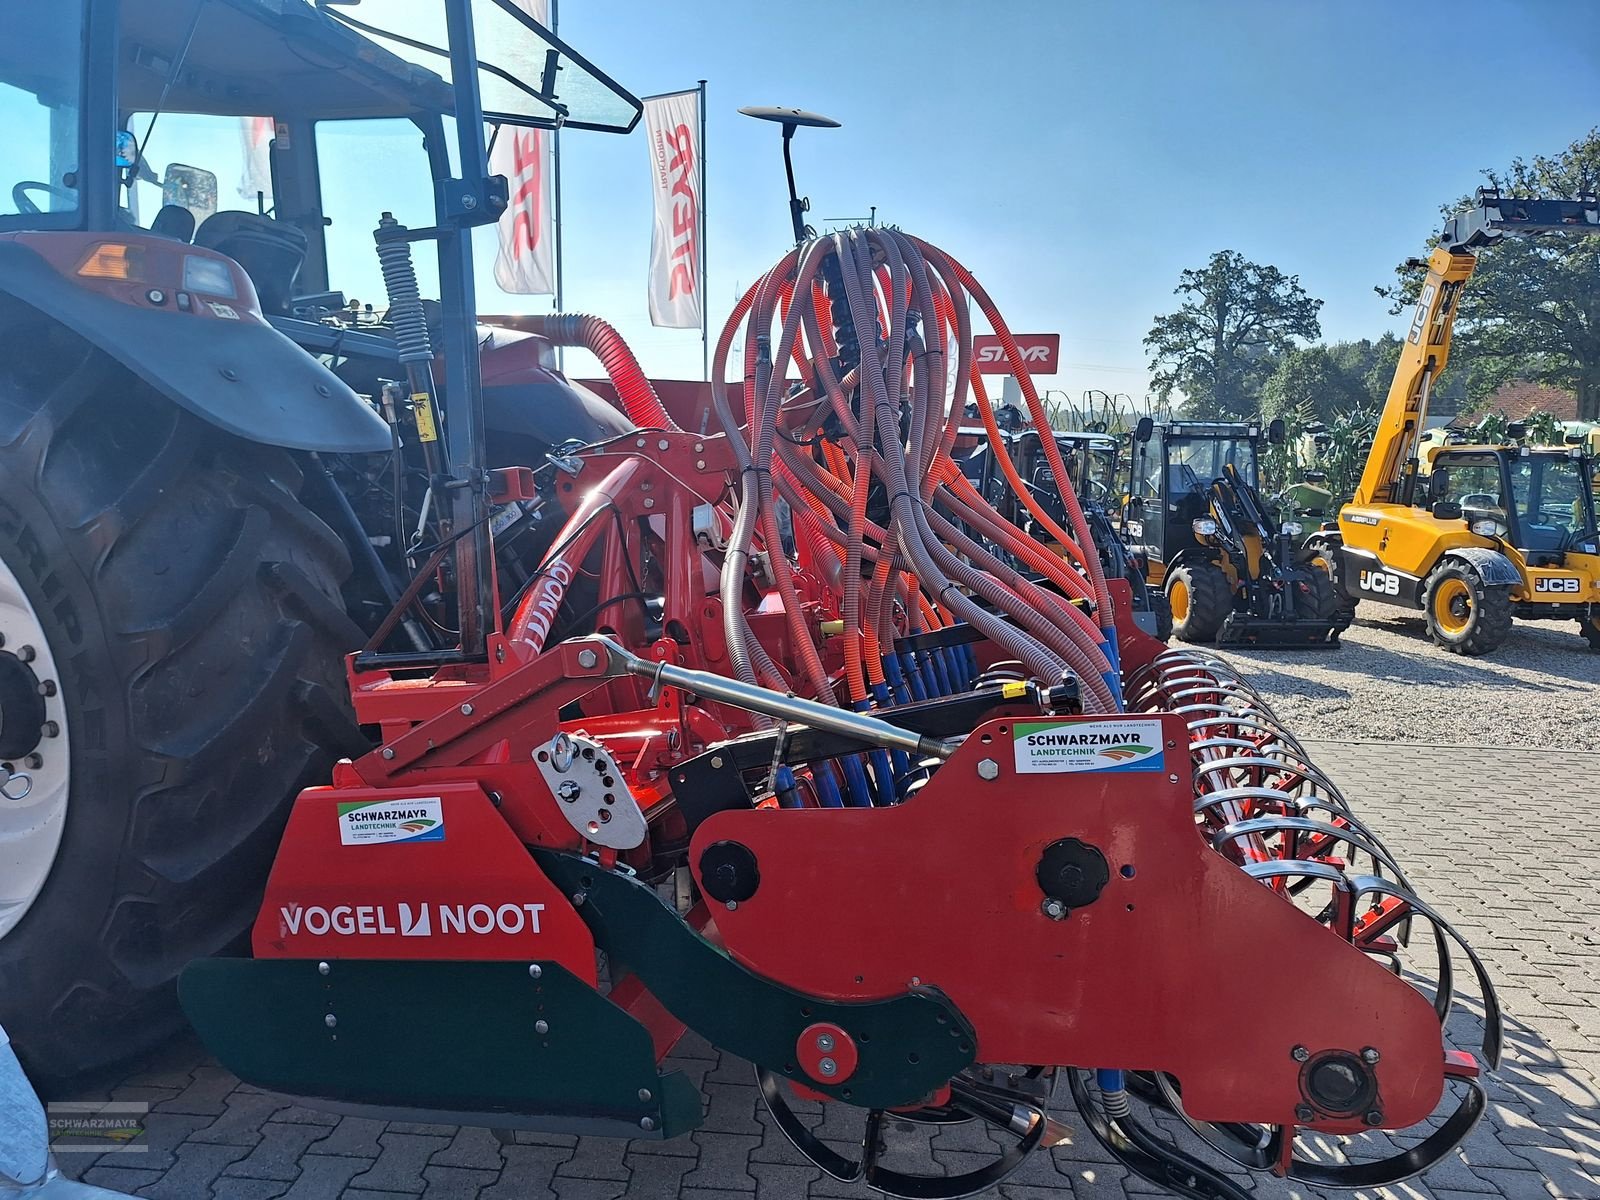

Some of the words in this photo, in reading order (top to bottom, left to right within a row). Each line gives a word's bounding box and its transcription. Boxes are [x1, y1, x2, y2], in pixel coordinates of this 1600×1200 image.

[1409, 285, 1435, 344] JCB
[977, 345, 1050, 362] STYR
[1360, 570, 1400, 596] JCB
[1535, 578, 1579, 592] JCB
[1027, 733, 1141, 746] SCHWARZMAYR
[1030, 748, 1096, 757] LANDTECHNIK
[348, 809, 427, 822] SCHWARZMAYR
[351, 822, 397, 831] LANDTECHNIK
[280, 905, 396, 936] VOGEL
[439, 903, 545, 935] NOOT
